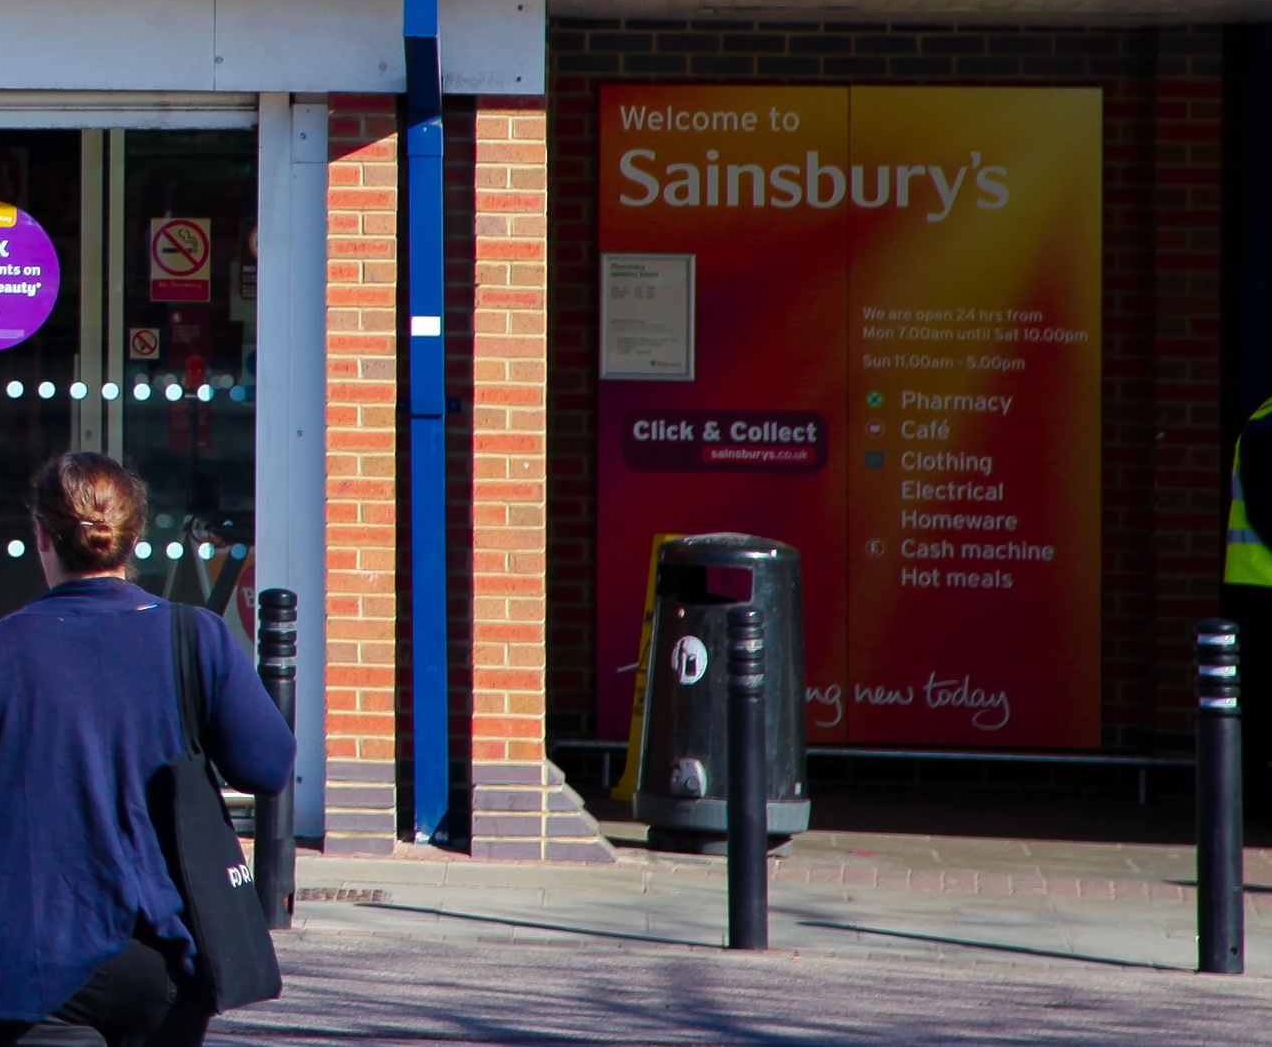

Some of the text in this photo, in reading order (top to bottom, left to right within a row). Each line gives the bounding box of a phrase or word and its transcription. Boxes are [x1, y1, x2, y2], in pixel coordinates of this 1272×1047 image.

[619, 105, 800, 132] Welcome to
[619, 148, 1010, 223] Sainsbury's
[23, 266, 41, 276] on
[862, 307, 1043, 324] We are open 24 hrs from
[862, 326, 1089, 344] Mon 7.00am until Sat 10.00pm
[862, 354, 891, 368] Sun
[966, 356, 1026, 371] 5.00pm
[901, 390, 1013, 416] Pharmacy
[632, 419, 817, 443] Click & Collect
[900, 419, 950, 440] Café
[710, 448, 809, 462] sainsburys.co.uk
[900, 450, 994, 476] Clothing
[900, 480, 1005, 502] Electrical
[900, 509, 1019, 531] Homeware
[900, 538, 1055, 562] Cash machine
[900, 567, 1014, 590] Hot meals
[854, 683, 914, 705] new
[923, 671, 1011, 731] today
